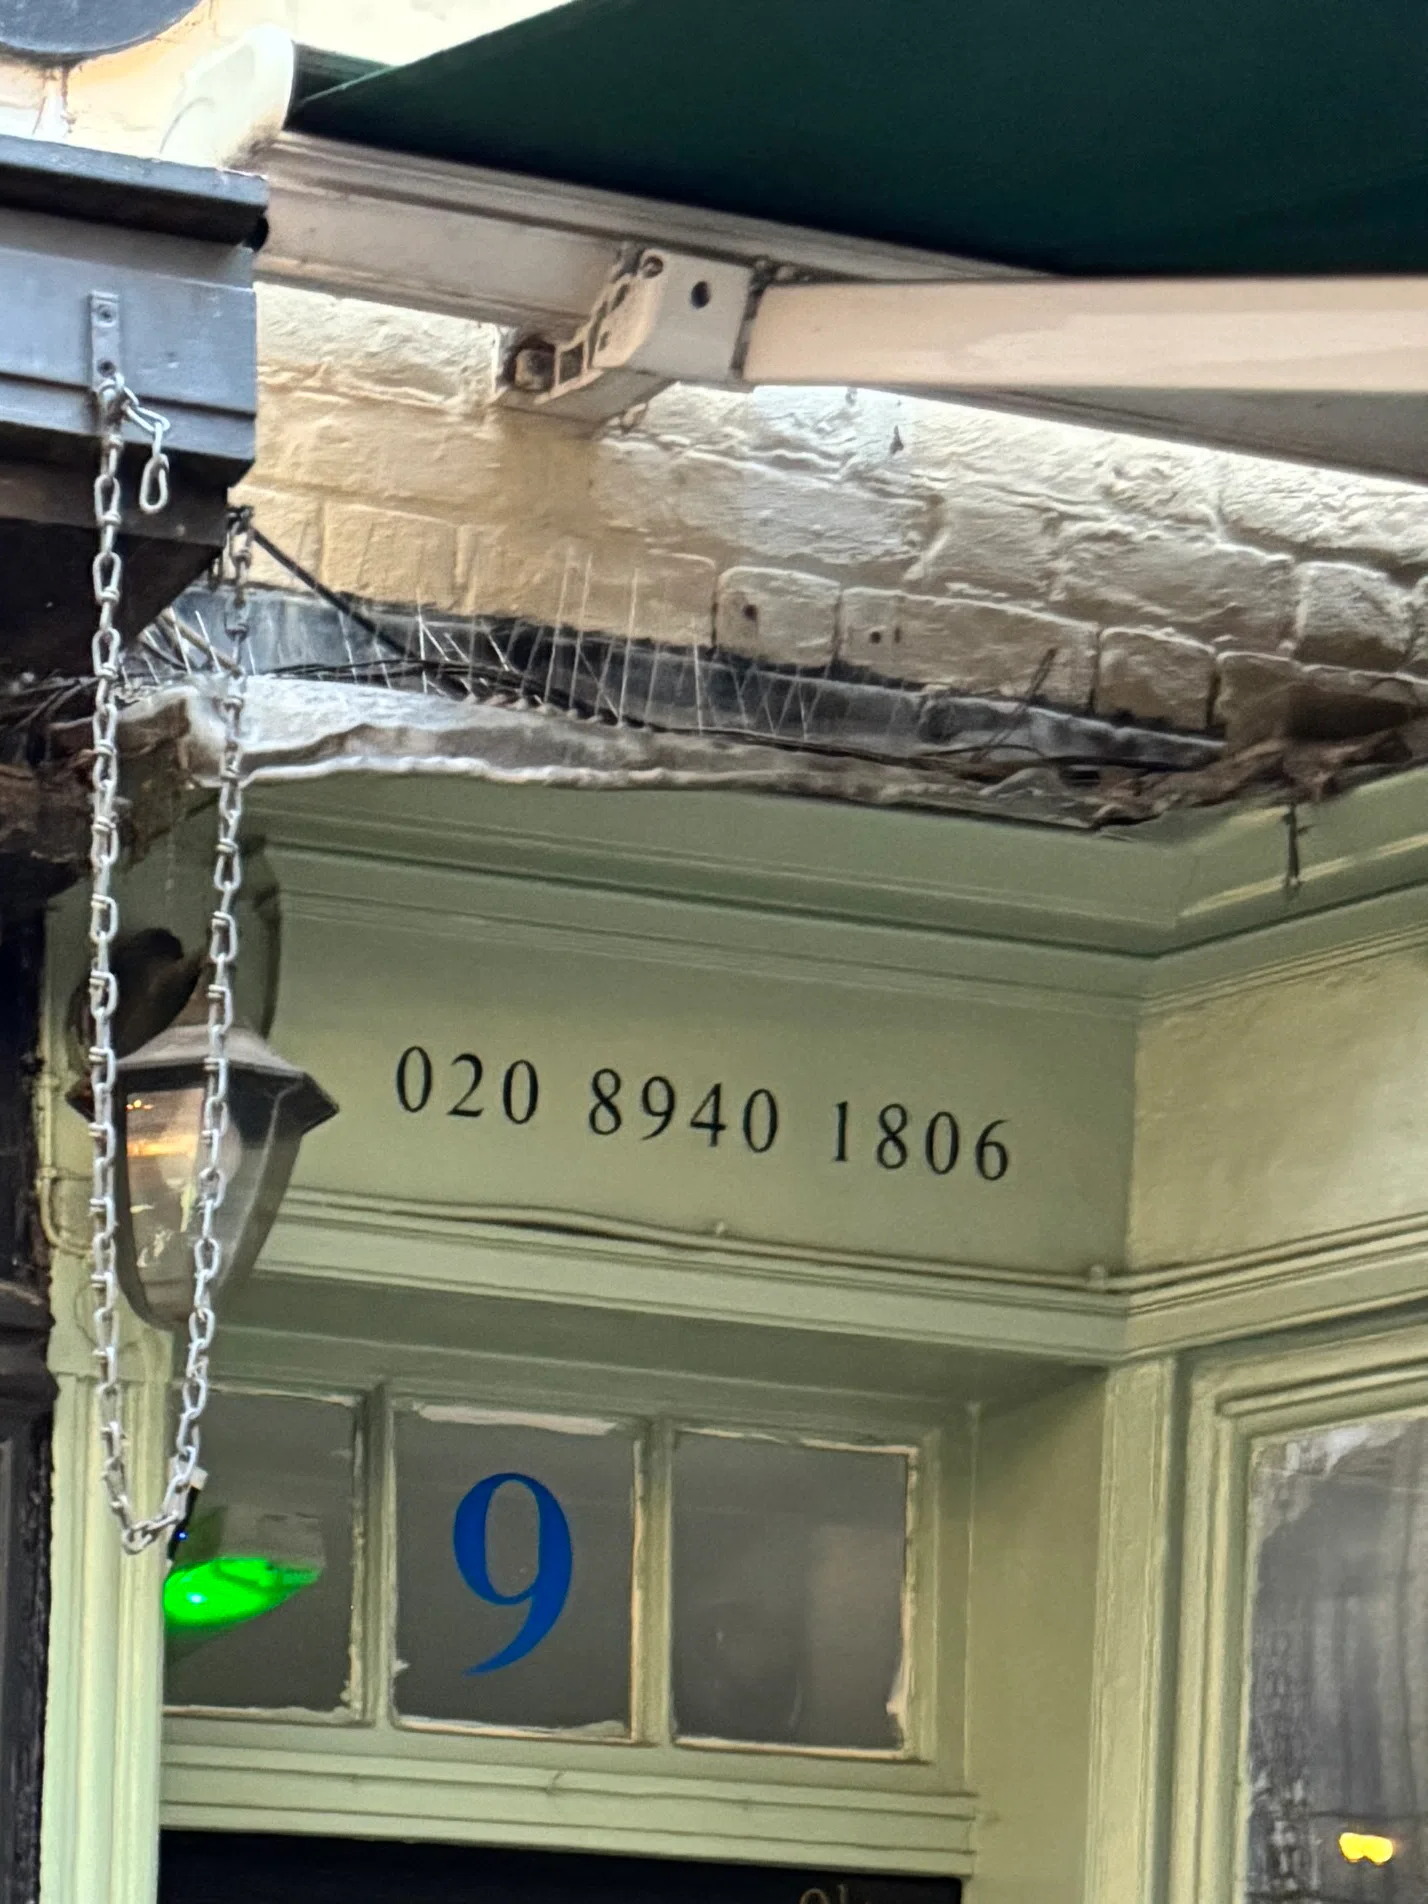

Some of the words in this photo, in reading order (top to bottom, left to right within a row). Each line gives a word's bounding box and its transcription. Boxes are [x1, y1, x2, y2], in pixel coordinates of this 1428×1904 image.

[396, 1045, 540, 1125] 020
[588, 1067, 780, 1153] 8940
[832, 1101, 1011, 1181] 1806
[451, 1470, 574, 1677] 9
